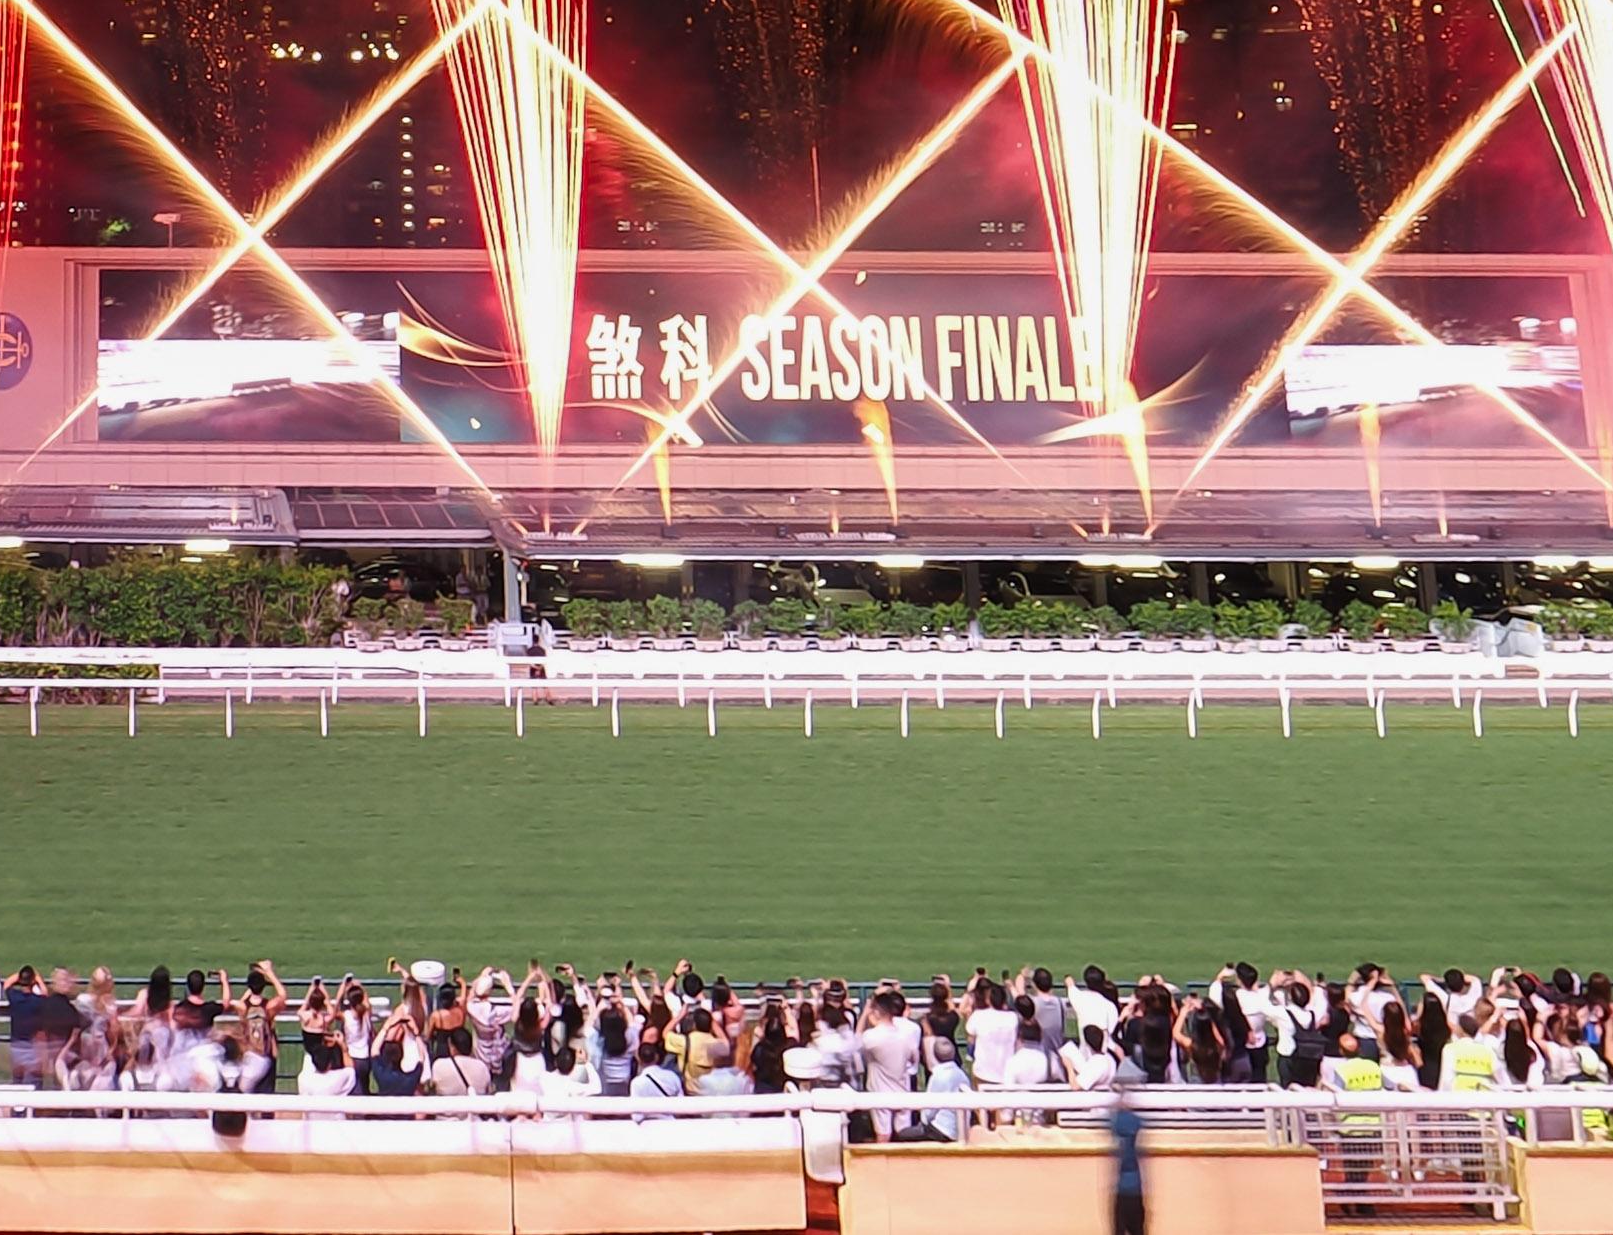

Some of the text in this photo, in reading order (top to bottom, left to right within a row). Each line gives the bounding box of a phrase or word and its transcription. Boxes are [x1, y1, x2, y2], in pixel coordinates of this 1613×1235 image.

[586, 314, 713, 400] 煞科
[739, 314, 1103, 401] SEASON FINALE
